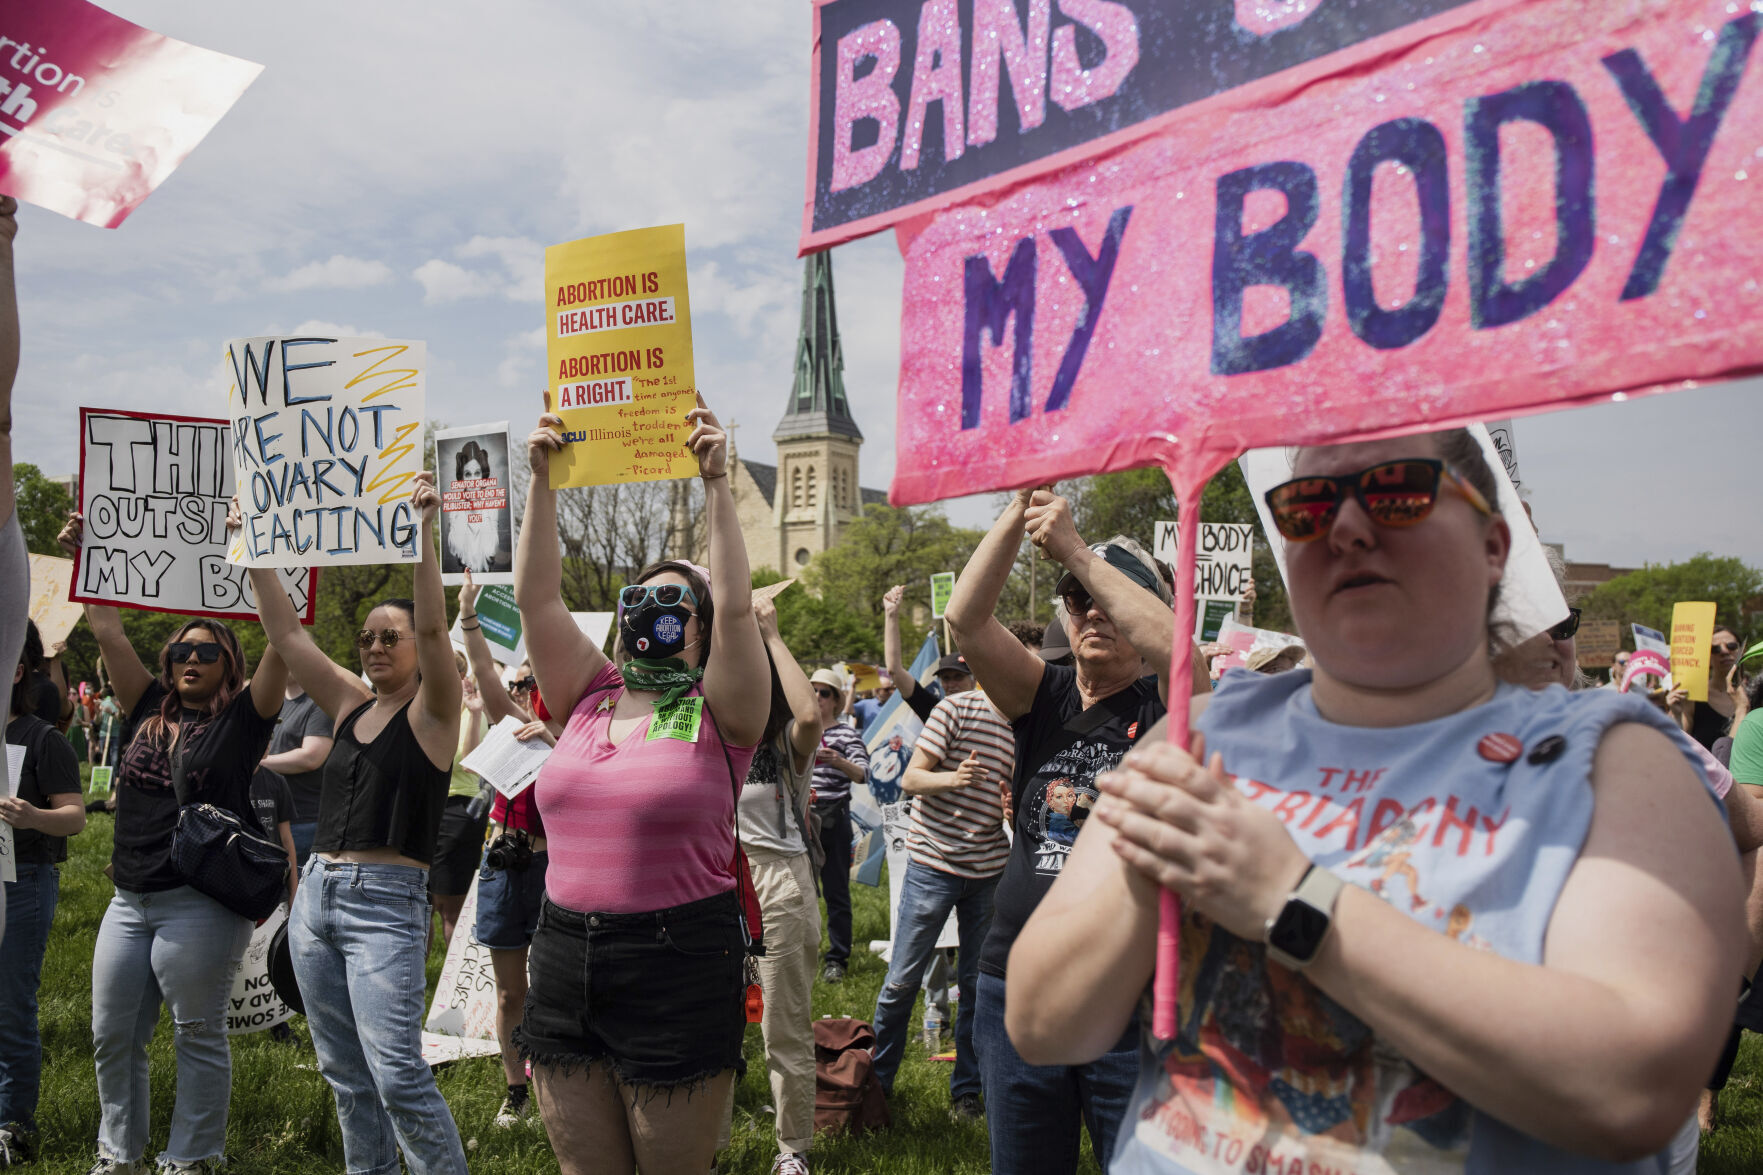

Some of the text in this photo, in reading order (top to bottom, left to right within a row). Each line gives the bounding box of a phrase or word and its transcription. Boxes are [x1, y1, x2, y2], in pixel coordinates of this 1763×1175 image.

[830, 0, 1140, 193] BANS
[960, 8, 1763, 432] MY BODY
[557, 271, 659, 306] ABORTION IS
[560, 300, 674, 335] HEALTH CARE.
[229, 337, 338, 409] WE
[559, 347, 664, 380] ABORTION IS
[561, 380, 631, 408] A RIGHT.
[663, 375, 677, 385] 1st
[618, 406, 677, 419] freedom is
[634, 392, 657, 402] time
[232, 405, 402, 472] ARE NOT
[561, 427, 632, 443] ACLU Illinois
[632, 420, 681, 432] trodden
[658, 433, 675, 443] all
[88, 415, 236, 499] THI
[251, 454, 368, 513] OVARY
[89, 494, 230, 545] OUTSI
[242, 501, 418, 562] REACTING
[1161, 523, 1254, 552] M BODY
[83, 546, 176, 598] MY
[655, 624, 681, 632] ABORTION
[660, 616, 678, 625] KEEP
[653, 720, 693, 733] APOLOGY!
[1318, 766, 1390, 793] THE
[226, 1008, 275, 1029] SOME
[1213, 1131, 1244, 1167] TO
